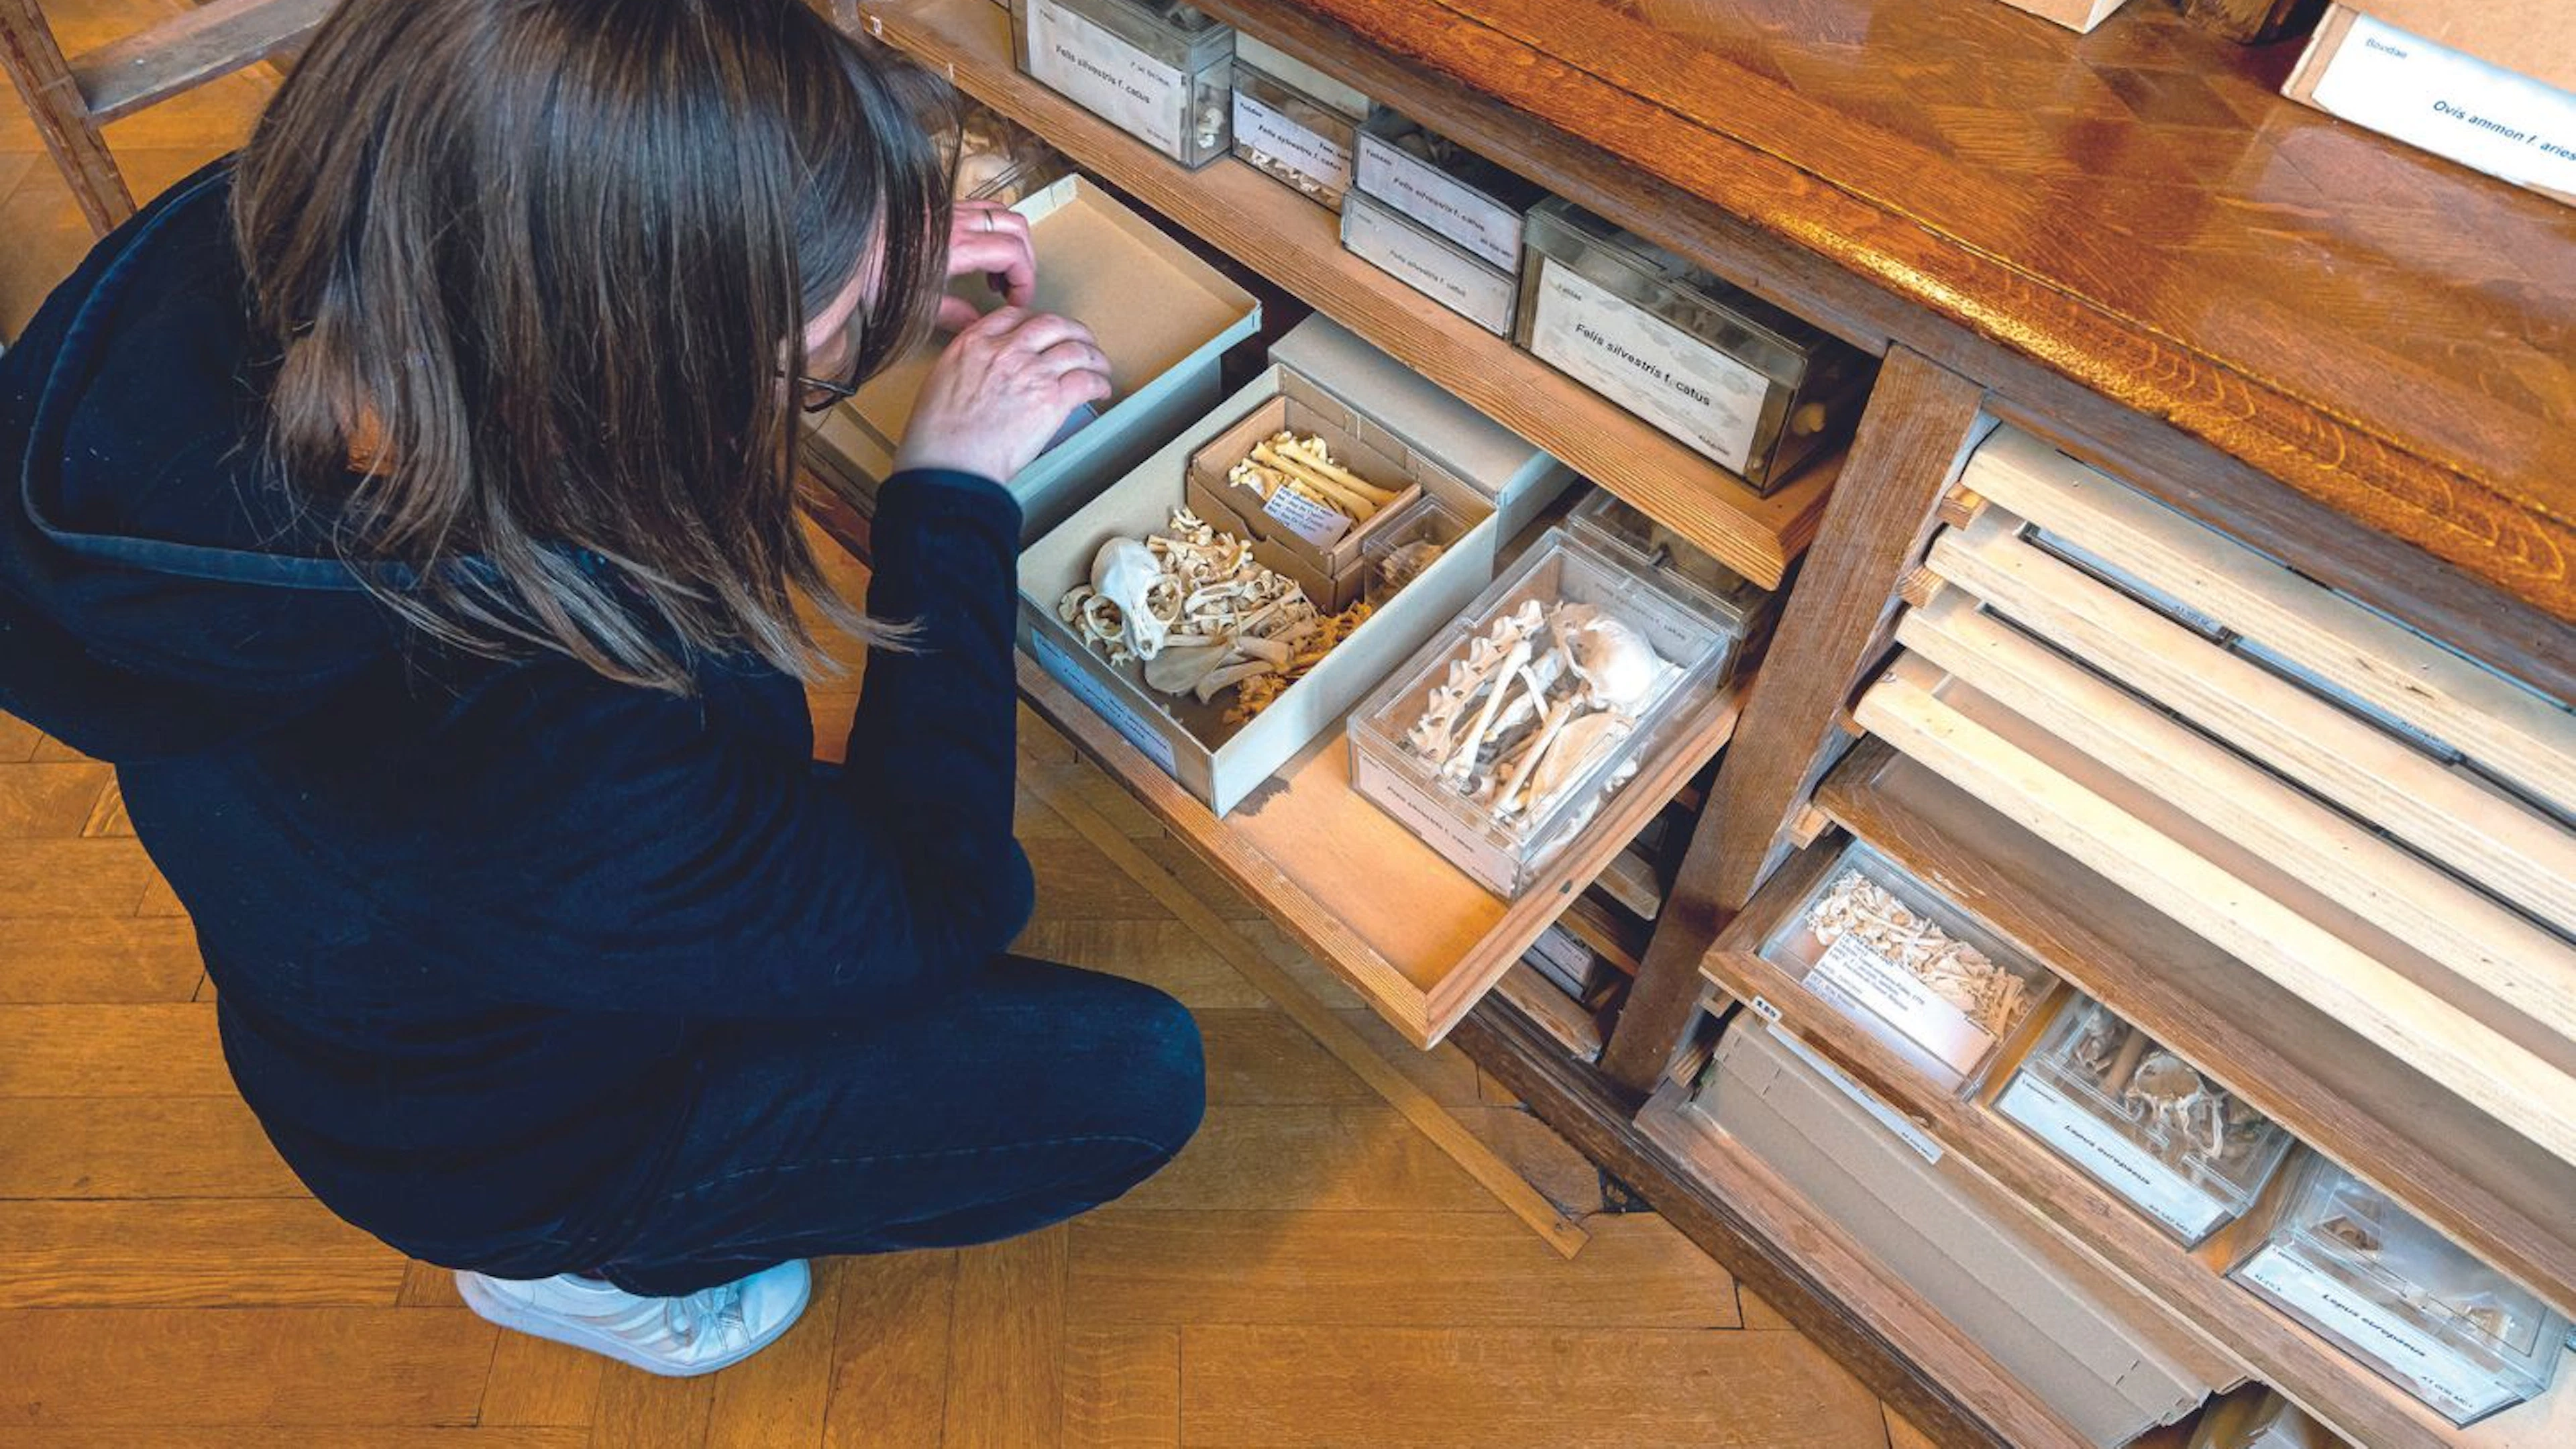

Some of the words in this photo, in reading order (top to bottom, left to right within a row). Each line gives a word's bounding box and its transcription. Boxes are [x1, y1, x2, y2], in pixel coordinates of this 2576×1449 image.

[2433, 100, 2467, 120] Ovis
[2469, 115, 2525, 142] ammon
[1576, 323, 1604, 346] Felis
[1605, 342, 1662, 379] silvestris
[1662, 372, 1672, 386] f.
[1676, 380, 1711, 407] catus
[2322, 1293, 2359, 1318] Lepus
[2361, 1316, 2426, 1357] europaeus
